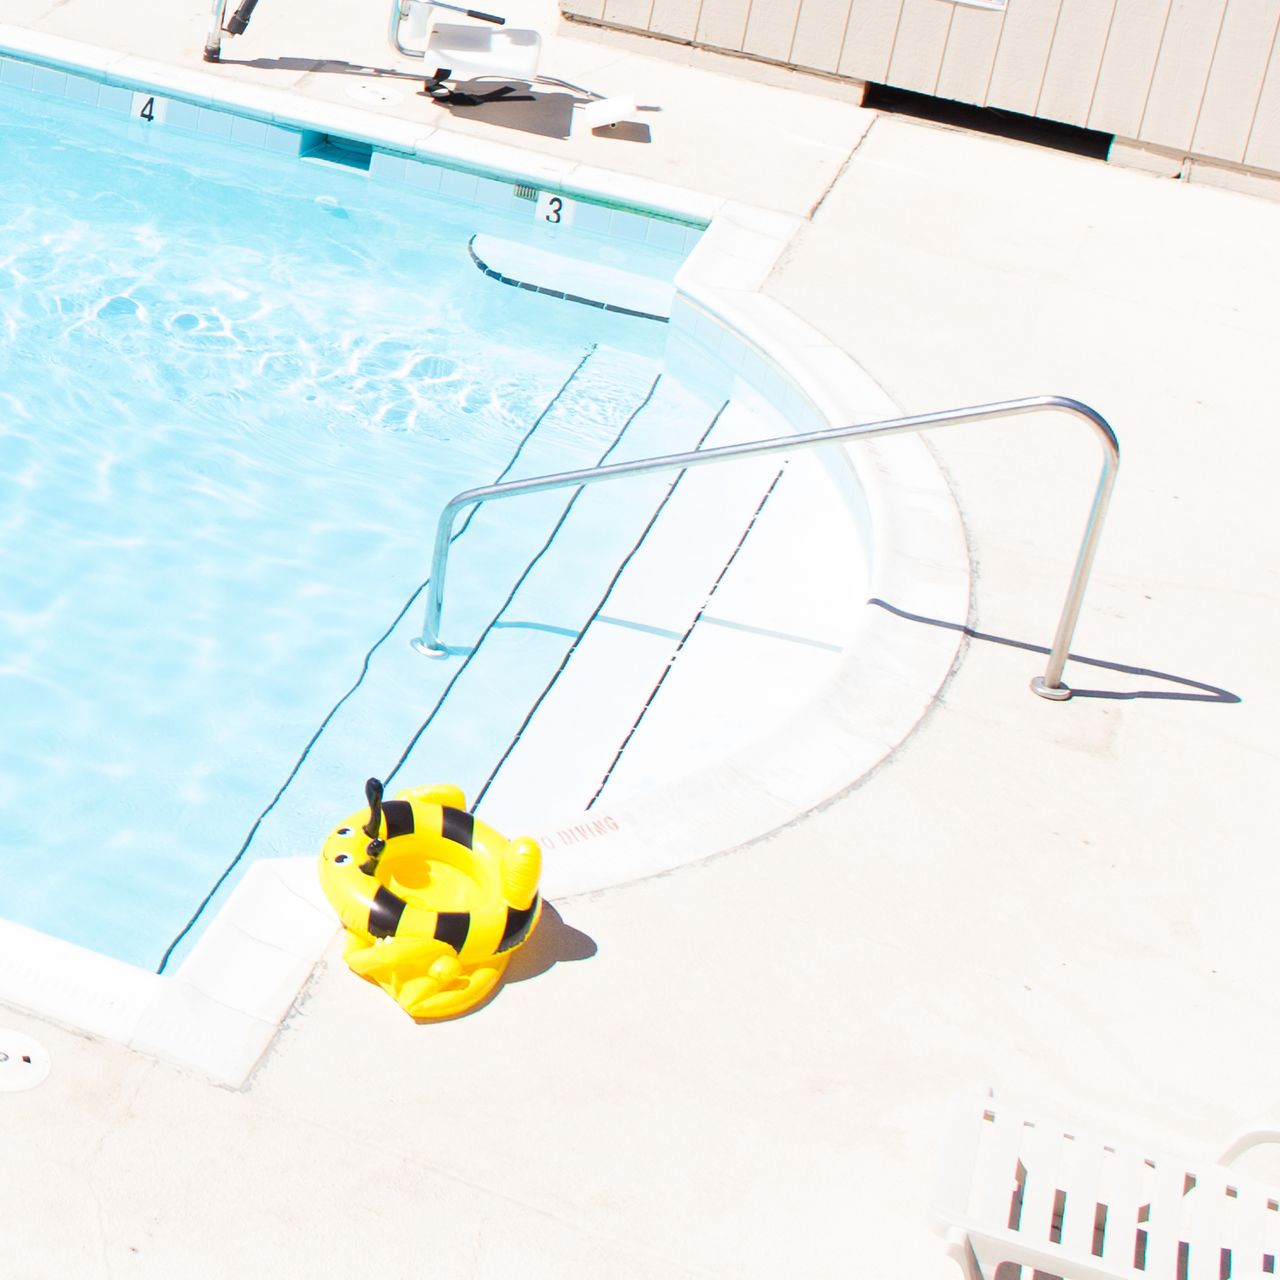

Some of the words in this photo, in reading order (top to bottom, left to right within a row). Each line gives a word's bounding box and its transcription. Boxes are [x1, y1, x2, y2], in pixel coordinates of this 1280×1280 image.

[140, 97, 155, 122] 4
[546, 197, 563, 224] 3
[556, 815, 620, 846] DIVING
